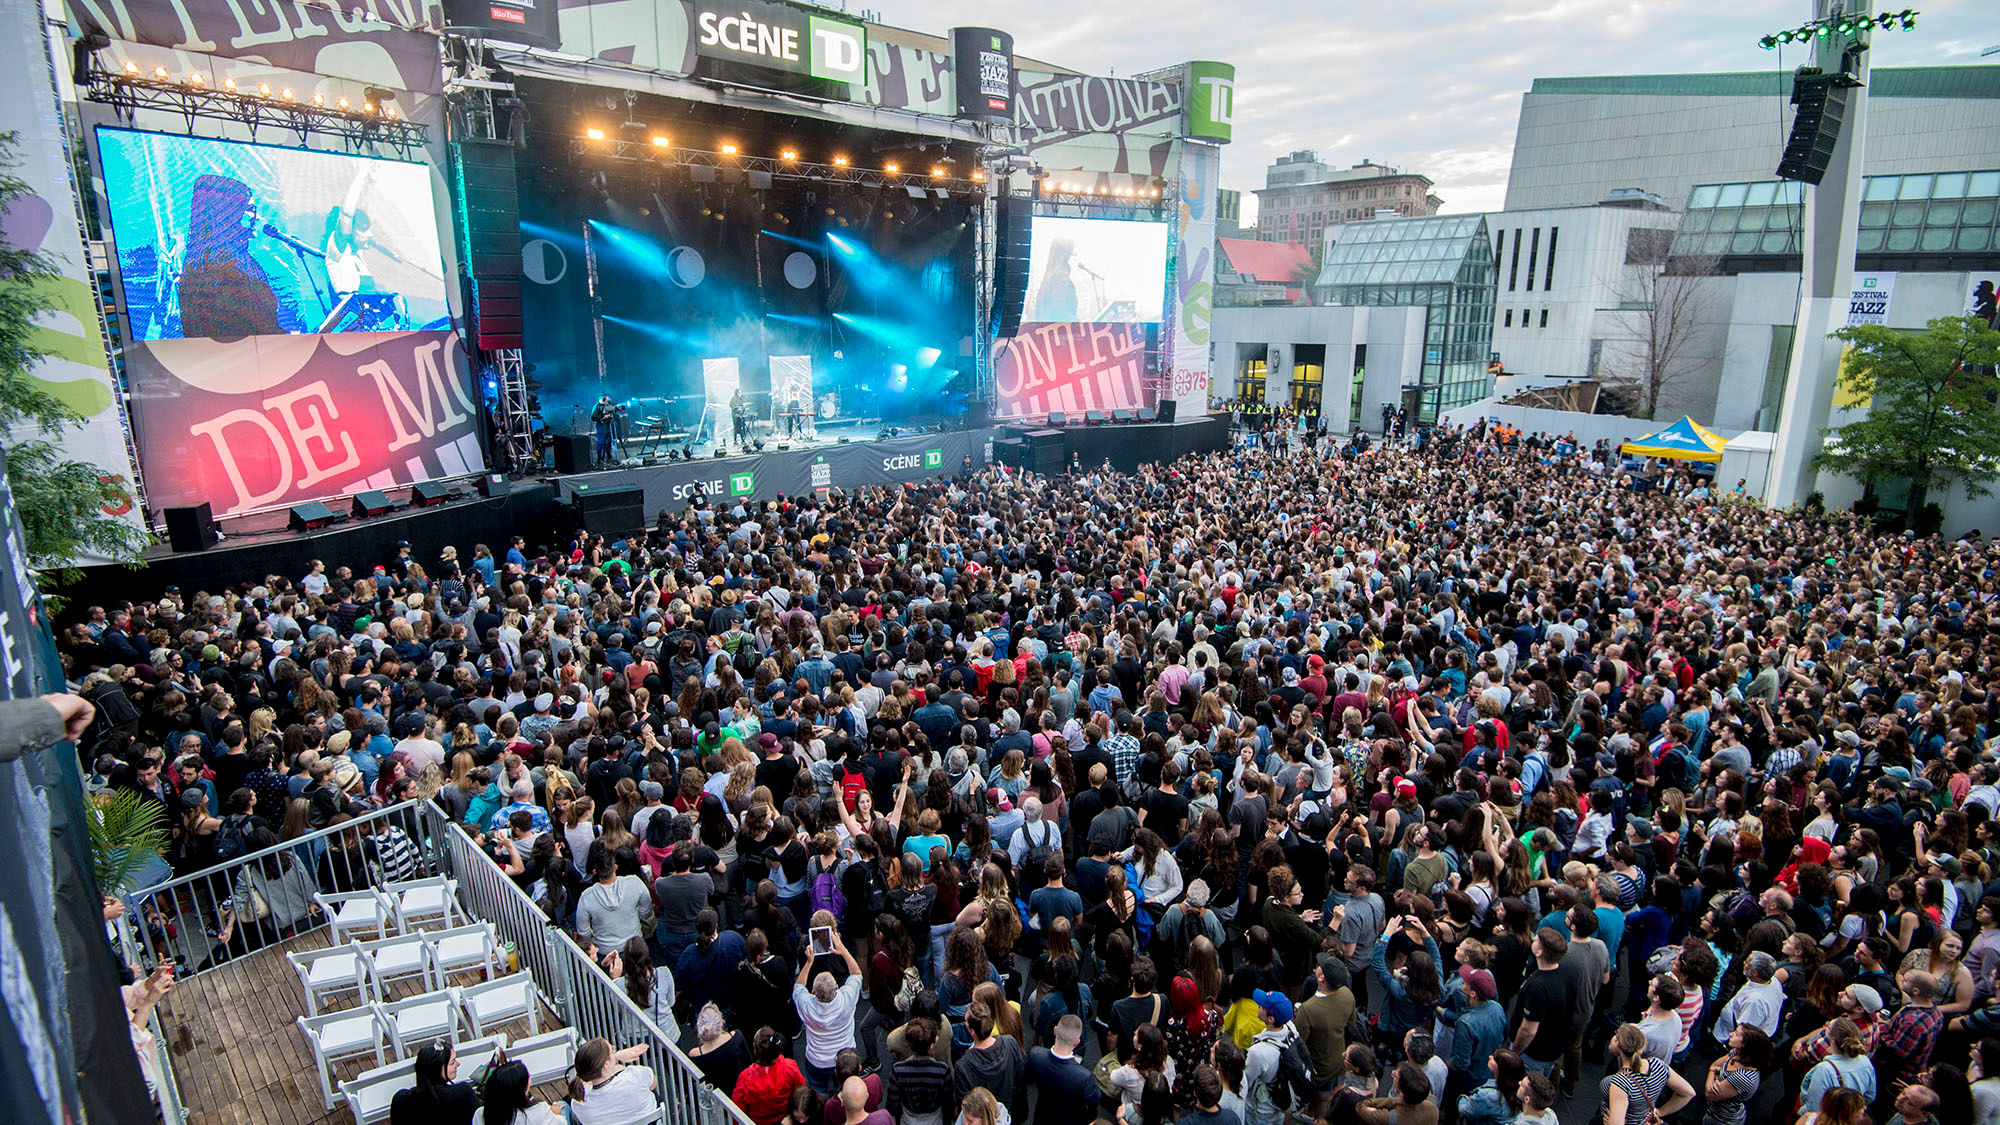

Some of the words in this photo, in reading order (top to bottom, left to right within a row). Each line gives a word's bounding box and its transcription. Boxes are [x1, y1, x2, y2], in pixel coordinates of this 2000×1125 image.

[699, 11, 799, 62] SCÈNE
[815, 28, 860, 72] TD
[981, 66, 1008, 84] JAZZ
[1185, 371, 1207, 391] 375
[190, 380, 360, 514] DE
[883, 453, 920, 471] SCÈNE
[927, 452, 941, 465] TD
[732, 476, 752, 491] TD
